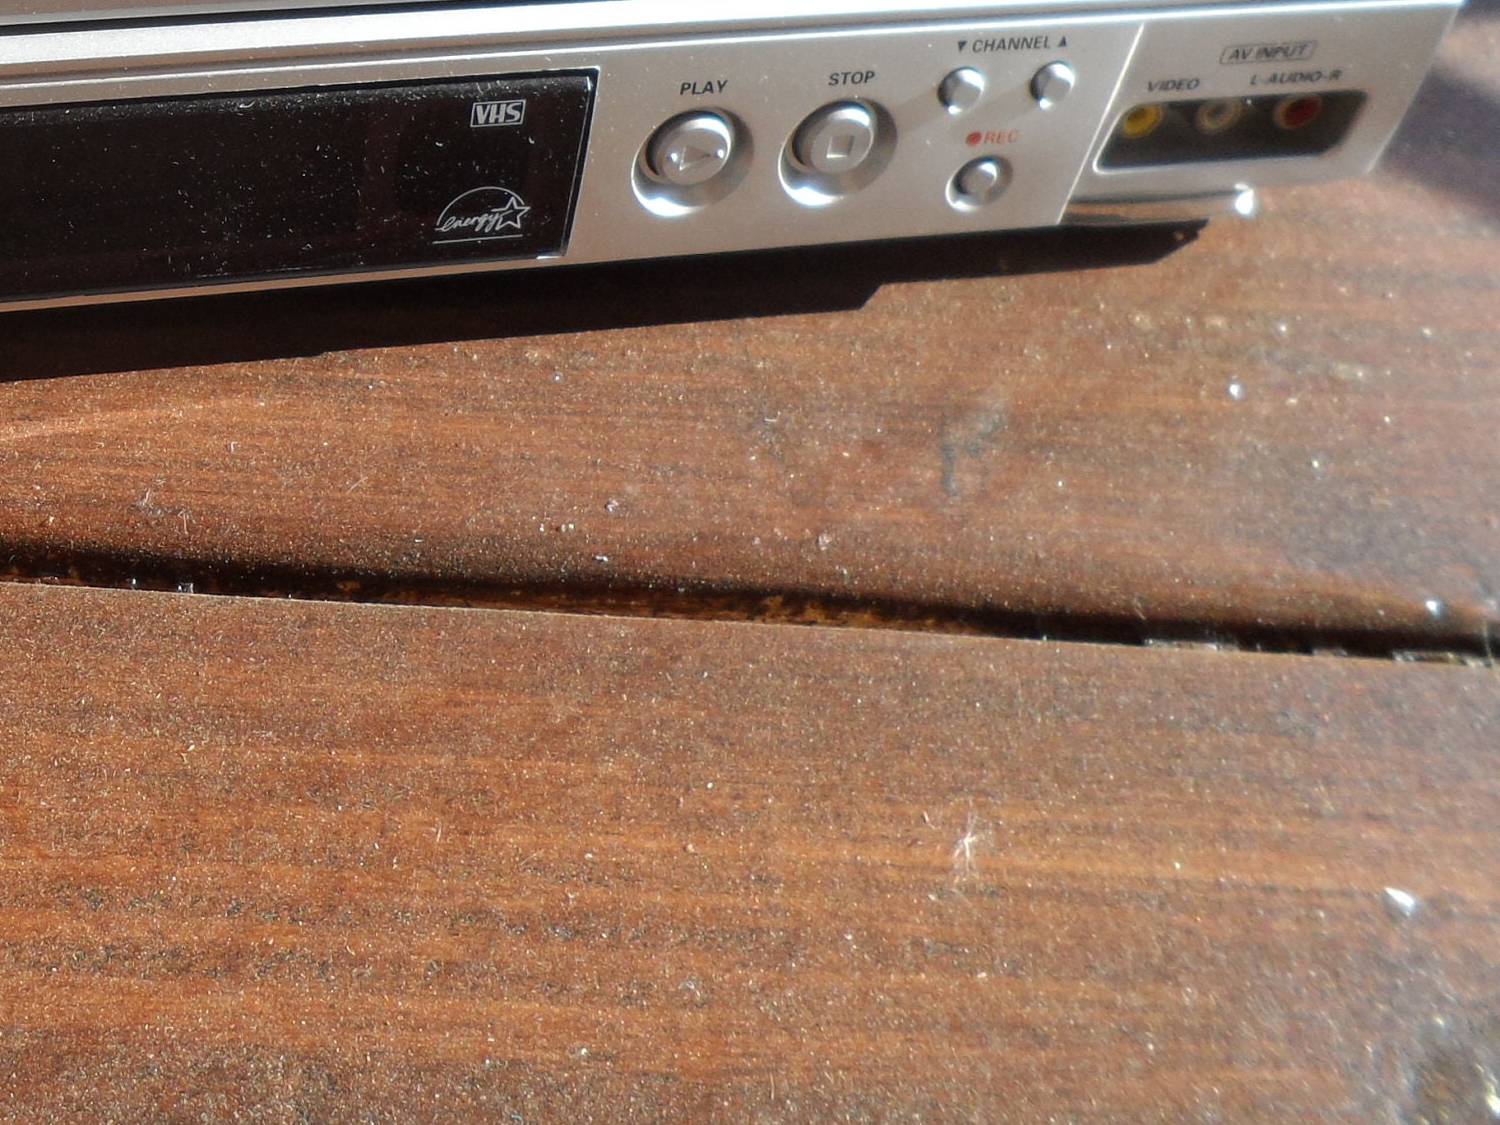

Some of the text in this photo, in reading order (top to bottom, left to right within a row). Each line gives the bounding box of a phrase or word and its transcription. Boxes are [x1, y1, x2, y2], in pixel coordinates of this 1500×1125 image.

[972, 35, 1053, 53] CHANNEL
[1228, 43, 1308, 60] AV INPUT
[829, 70, 875, 87] STOP
[1147, 77, 1200, 93] VIDEO
[680, 79, 729, 96] PLAY
[475, 101, 523, 125] VHS
[985, 129, 1020, 145] REC
